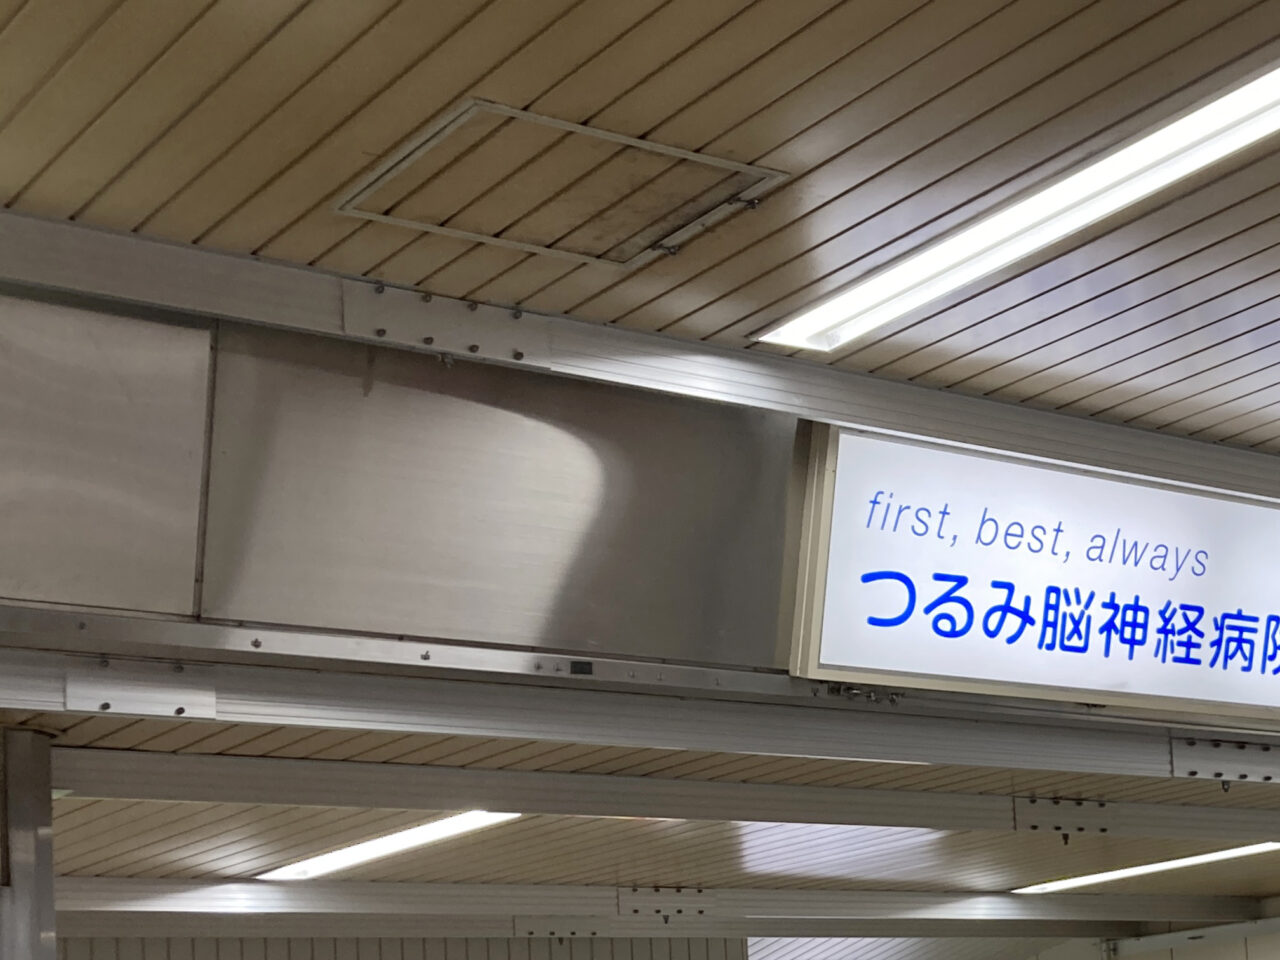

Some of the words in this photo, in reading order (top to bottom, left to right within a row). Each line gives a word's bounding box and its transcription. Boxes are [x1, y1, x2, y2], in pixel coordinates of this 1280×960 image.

[866, 491, 958, 547] first,
[975, 508, 1070, 563] best,
[1086, 528, 1209, 581] always
